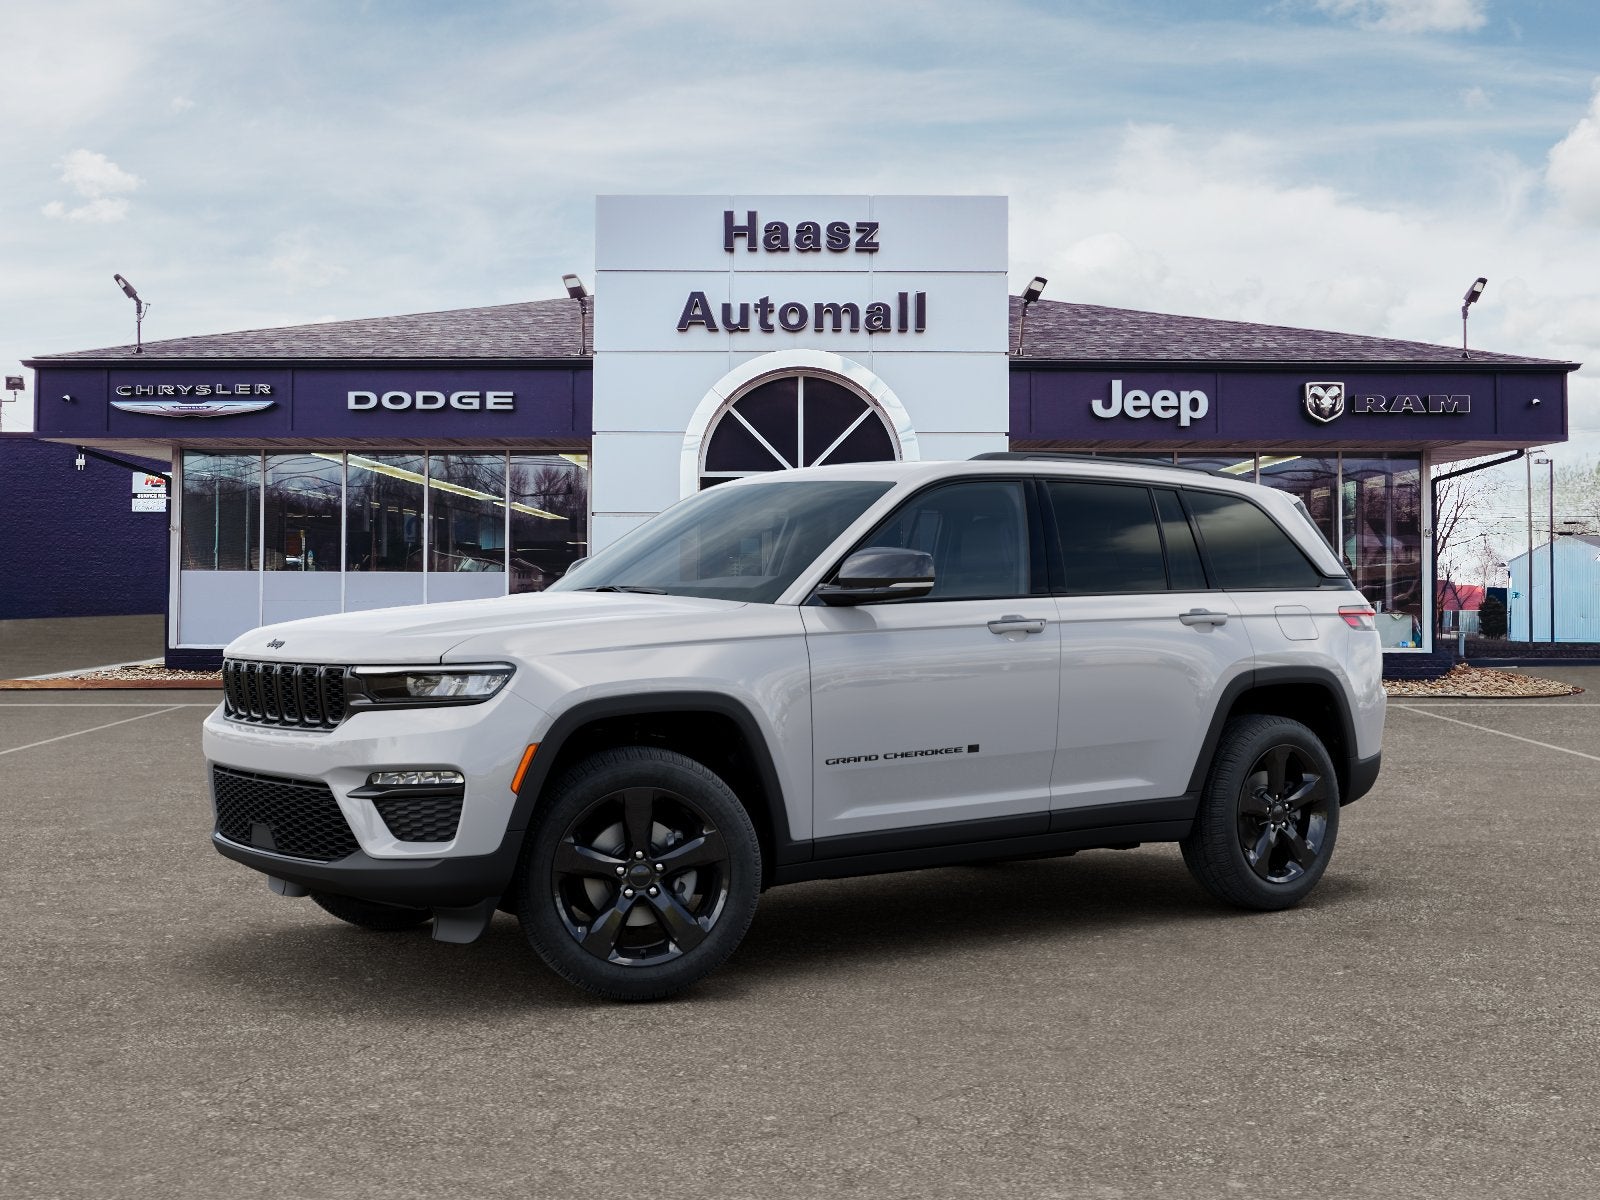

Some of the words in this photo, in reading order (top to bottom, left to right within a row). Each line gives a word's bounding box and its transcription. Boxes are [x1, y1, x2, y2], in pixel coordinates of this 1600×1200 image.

[723, 210, 880, 252] Haasz
[677, 290, 928, 334] Automall
[115, 383, 271, 396] CHRYSLER
[347, 390, 514, 410] DODGE
[1091, 379, 1209, 427] Jeep
[1354, 394, 1471, 413] RAM
[825, 754, 879, 766] GRAND
[883, 746, 964, 760] CHEROKEE
